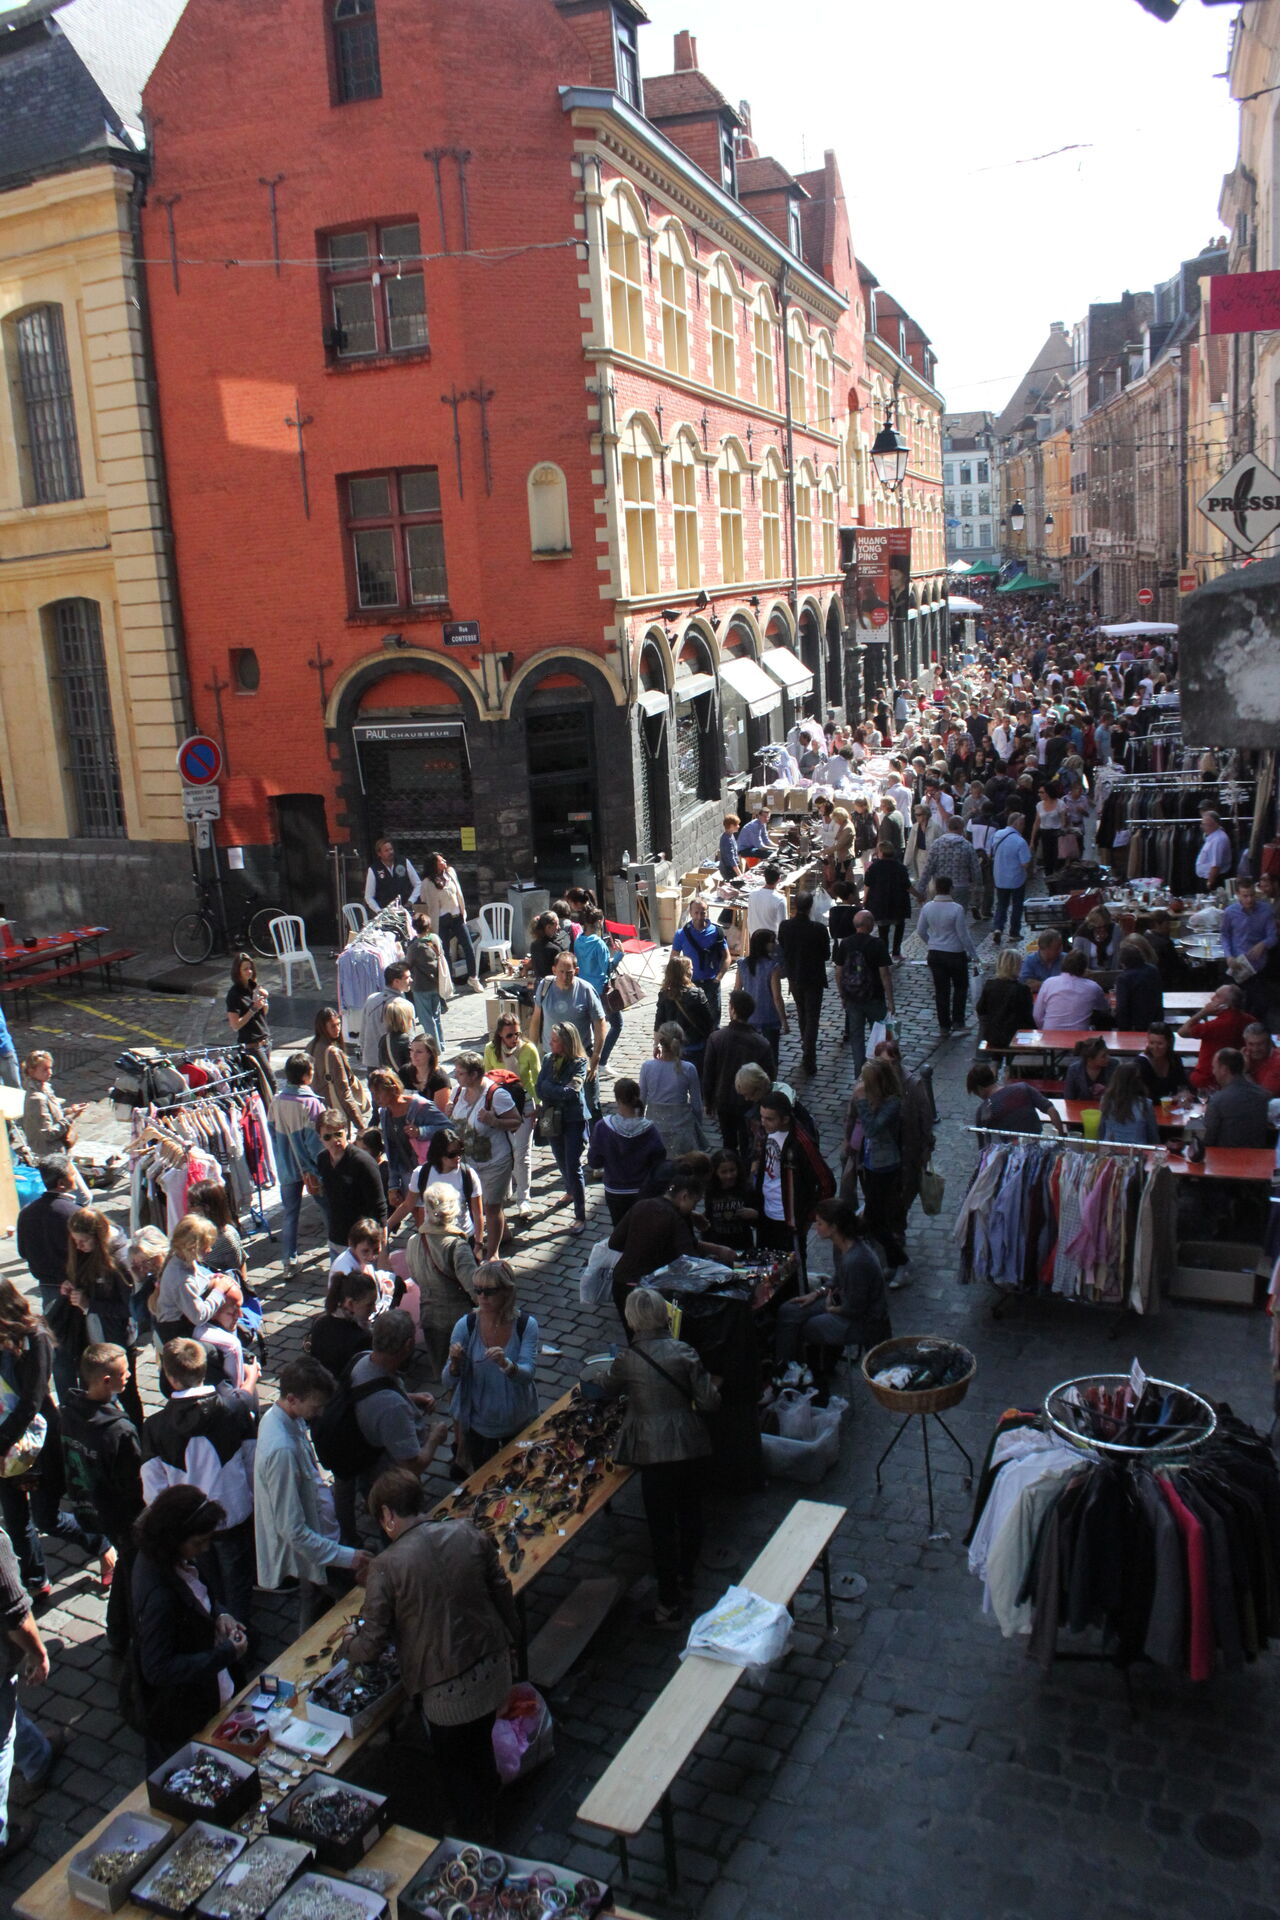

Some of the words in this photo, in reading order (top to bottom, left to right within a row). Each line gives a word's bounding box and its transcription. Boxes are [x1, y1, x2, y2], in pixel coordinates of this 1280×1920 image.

[858, 536, 887, 545] HUANG
[858, 544, 882, 553] YONG
[858, 552, 878, 561] PING
[366, 729, 389, 739] PAUL
[390, 730, 450, 739] CHAUSSEUR
